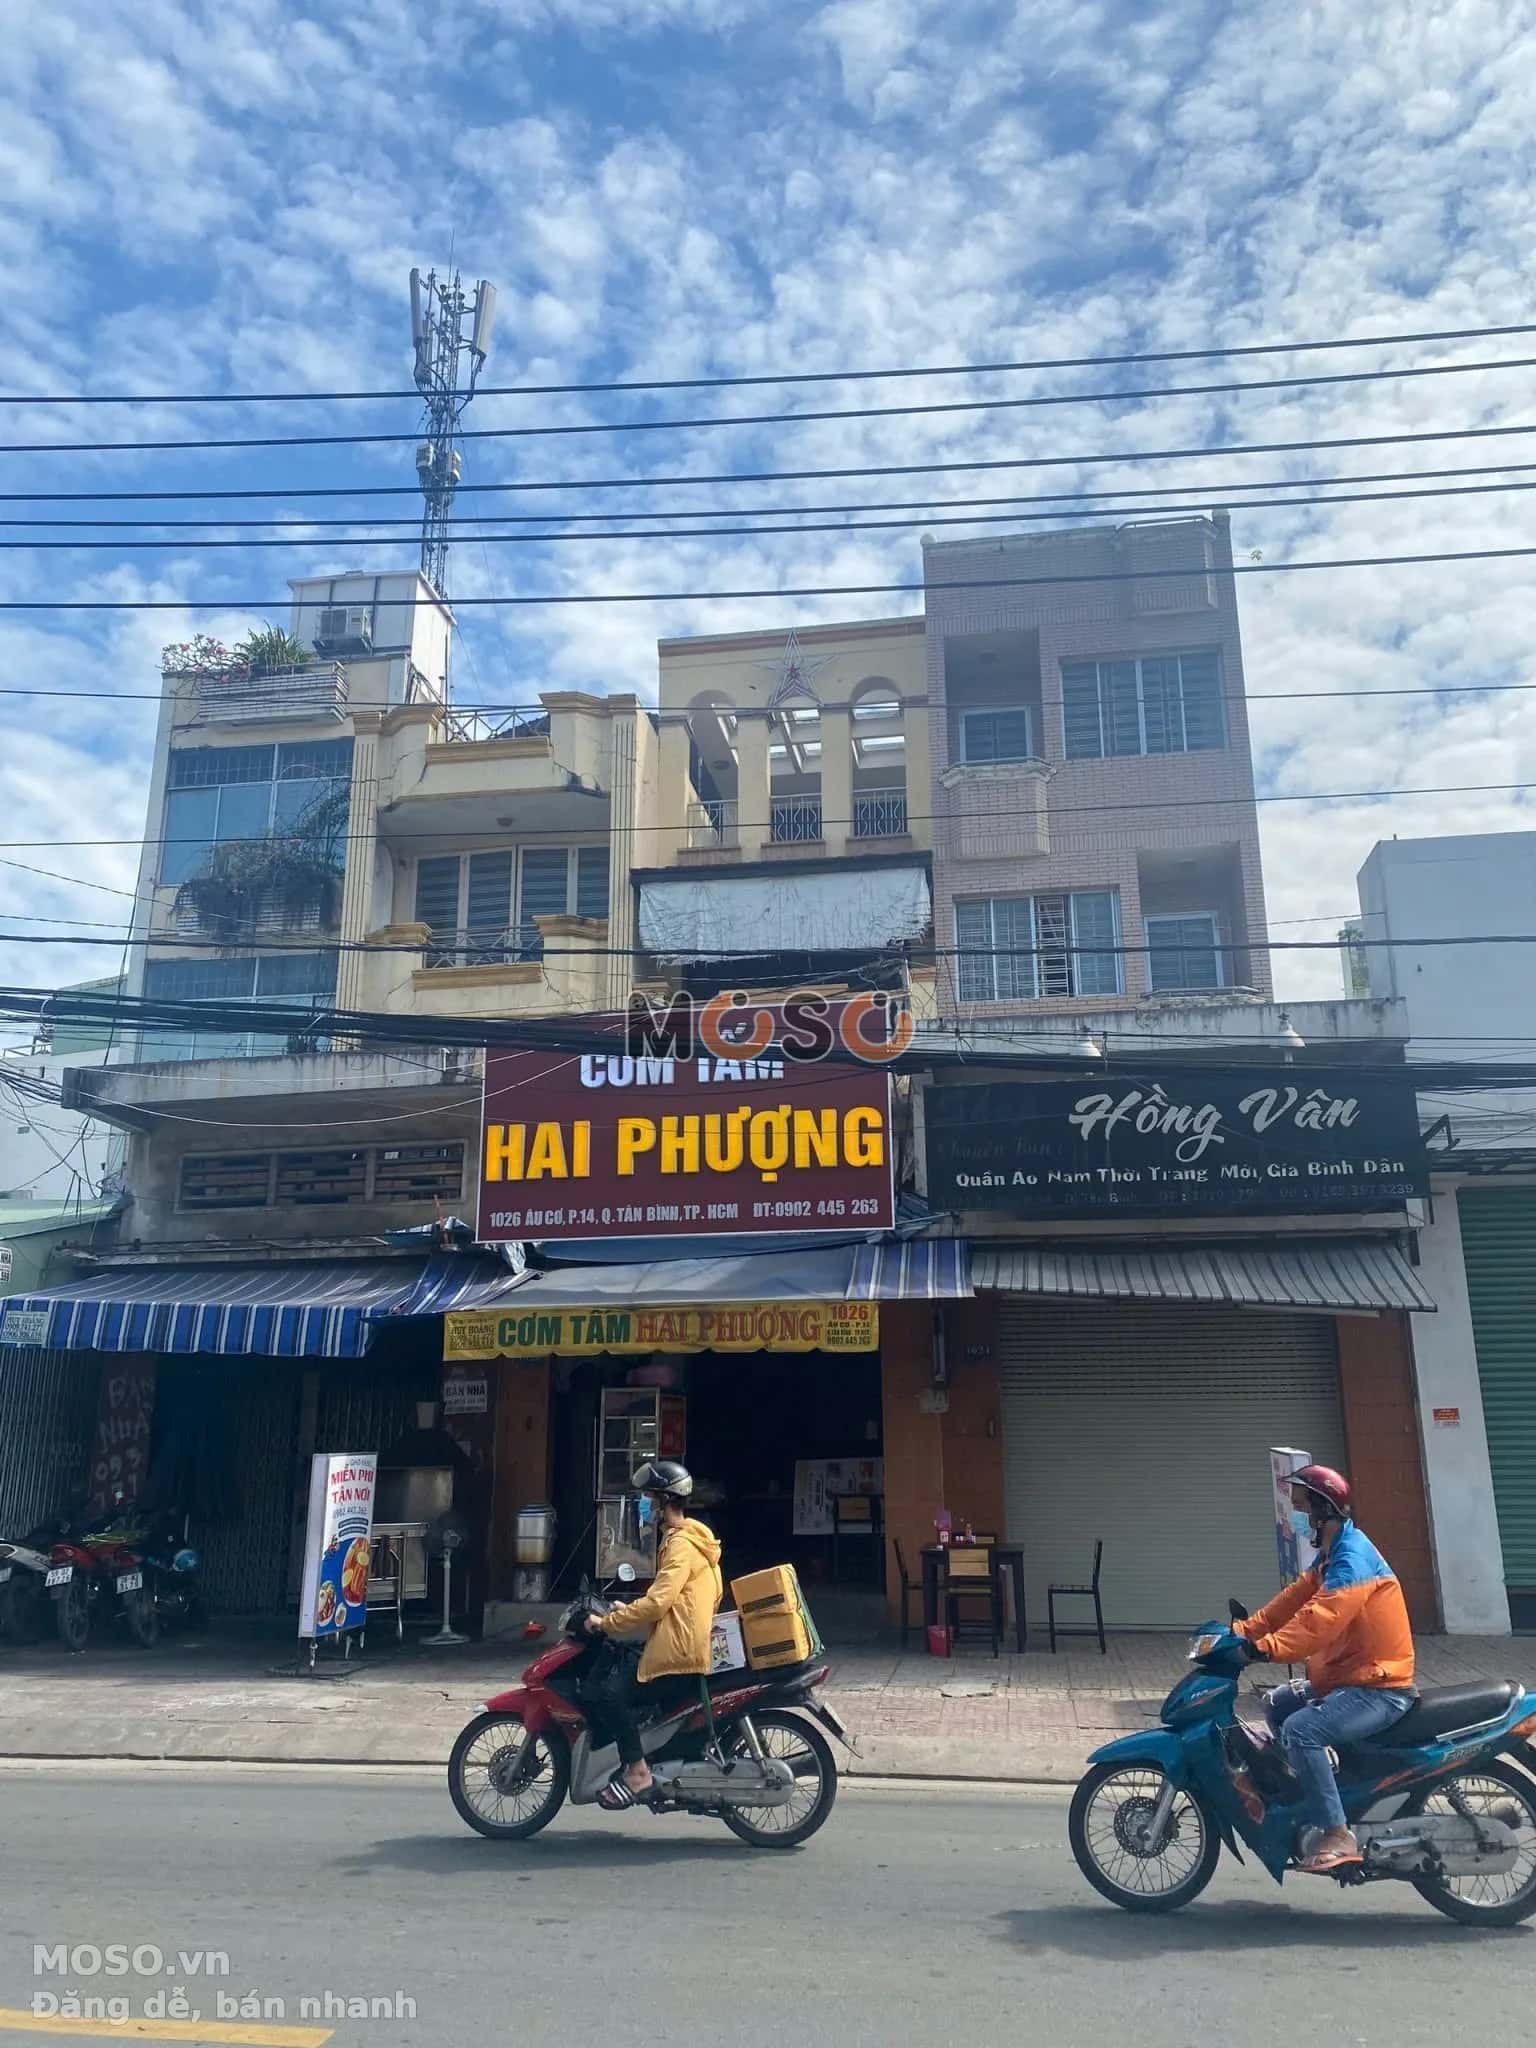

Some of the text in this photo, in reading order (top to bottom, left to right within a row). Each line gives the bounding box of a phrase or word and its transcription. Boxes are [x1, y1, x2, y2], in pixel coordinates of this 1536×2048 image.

[1069, 1083, 1361, 1162] Hồng Vân
[485, 1104, 885, 1183] HAI PHƯỢNG
[1048, 1169, 1091, 1184] Nam
[1147, 1164, 1209, 1183] Trang
[489, 1211, 522, 1228] 1026
[817, 1199, 846, 1216] 445
[851, 1198, 879, 1215] 263
[498, 1312, 562, 1347] CƠM
[570, 1309, 631, 1345] TẤM
[635, 1310, 689, 1343] HAI
[832, 1304, 868, 1321] 1026
